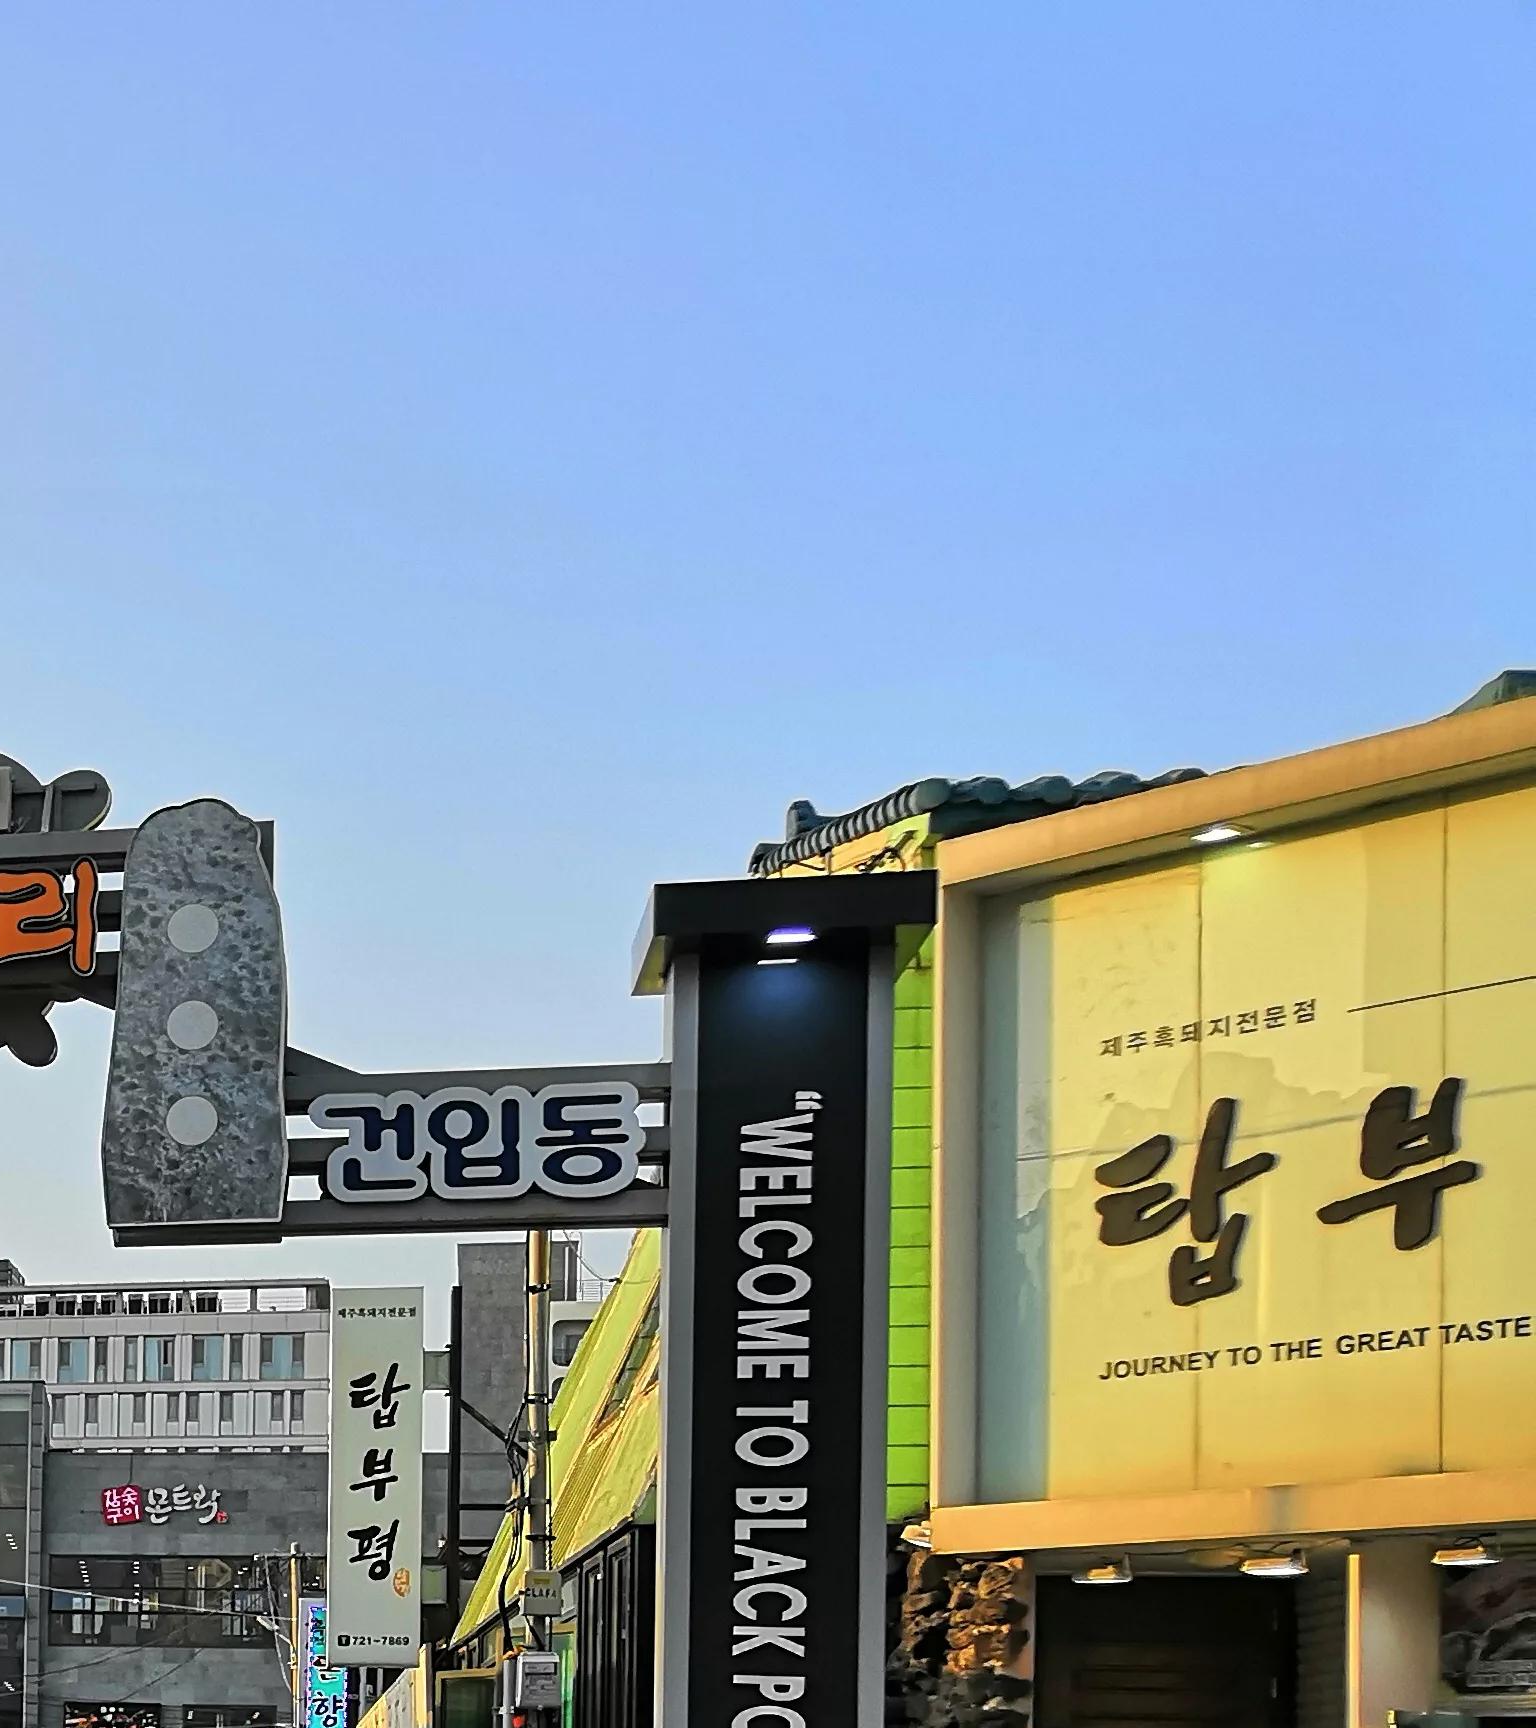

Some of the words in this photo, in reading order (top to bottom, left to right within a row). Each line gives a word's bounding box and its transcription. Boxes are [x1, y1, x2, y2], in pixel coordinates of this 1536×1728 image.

[1099, 999, 1318, 1058] 제주흑돼지전문점
[324, 1094, 630, 1191] 건입동
[1099, 1349, 1220, 1380] JOURNEY
[1228, 1345, 1263, 1367] TO
[1270, 1338, 1323, 1361] THE
[1336, 1326, 1431, 1355] GREAT
[1438, 1316, 1532, 1345] TASTE
[347, 1362, 411, 1581] 탑부평
[734, 1398, 811, 1468] TO
[732, 1486, 809, 1658] BLACK
